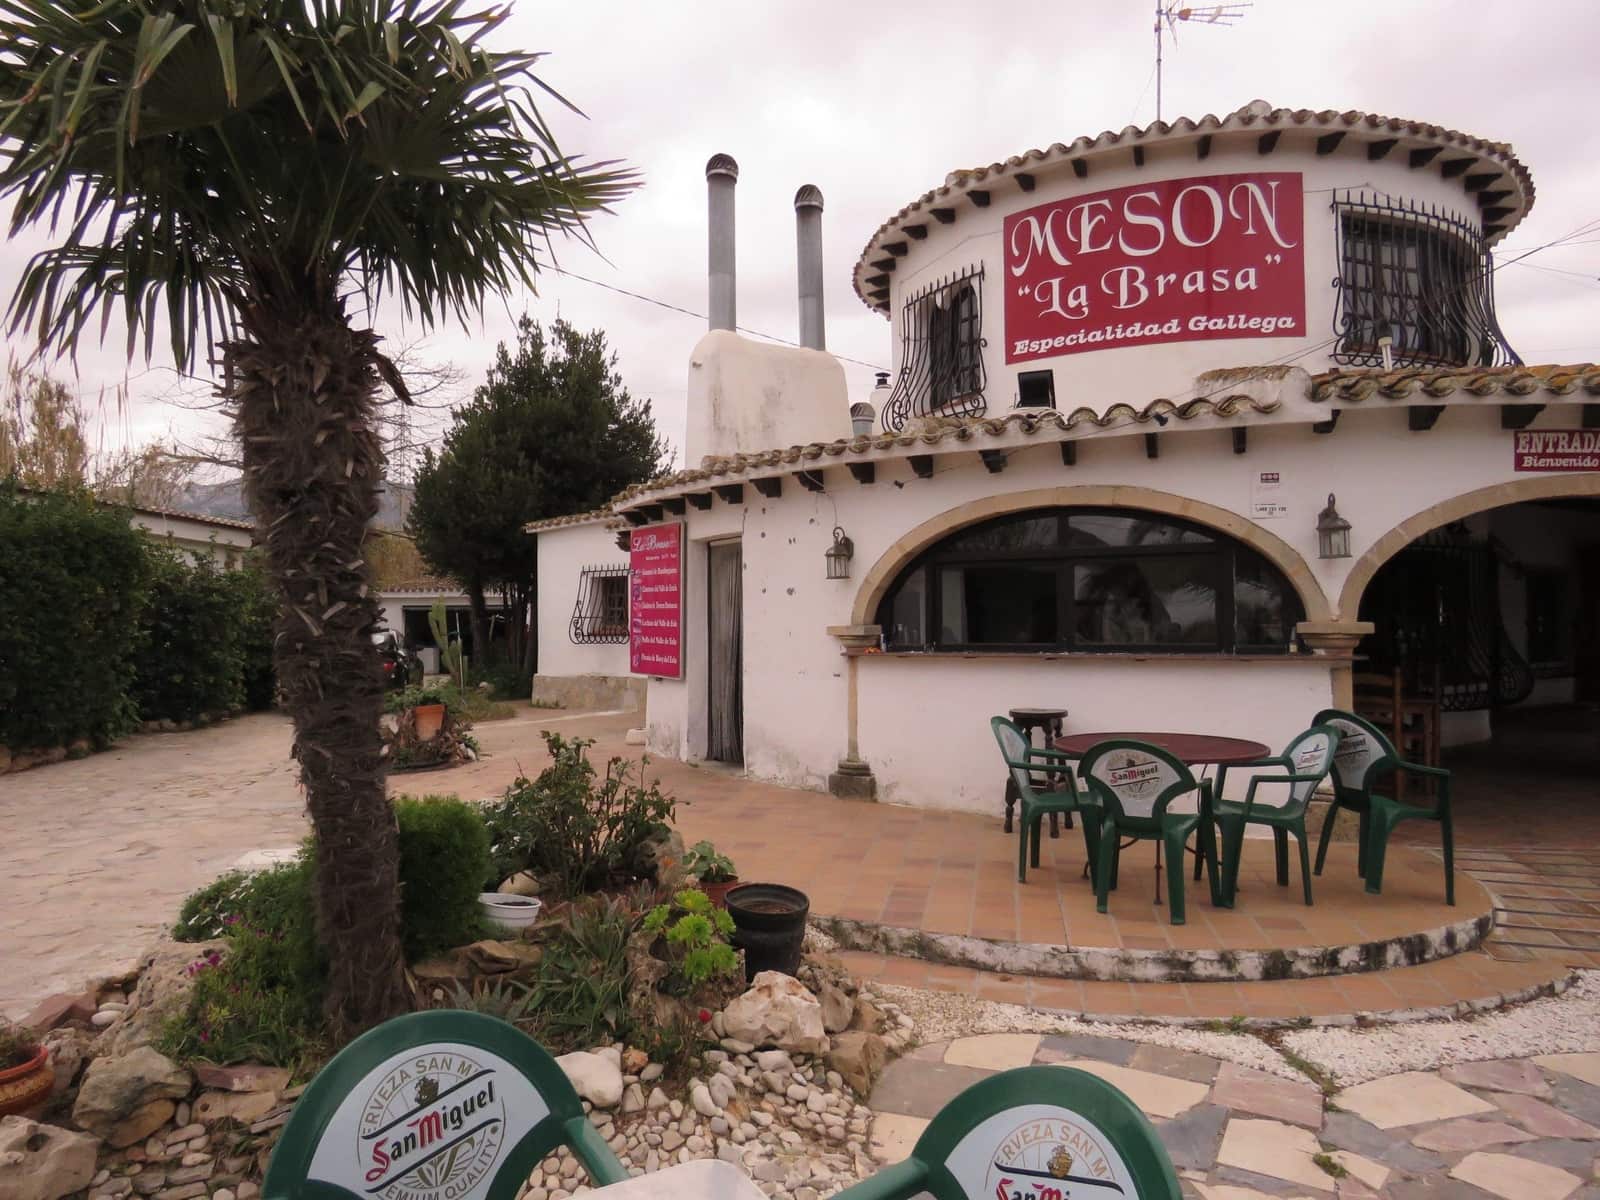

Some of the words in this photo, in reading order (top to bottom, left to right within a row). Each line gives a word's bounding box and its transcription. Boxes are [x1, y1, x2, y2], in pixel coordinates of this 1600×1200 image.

[1011, 181, 1297, 277] MESON
[1012, 319, 1181, 355] Especialidad
[1188, 314, 1295, 334] Gallega
[1521, 456, 1599, 467] Bienvenido
[416, 1057, 453, 1074] SAN
[457, 1061, 478, 1076] M
[1060, 1125, 1093, 1156] SAN
[445, 1139, 497, 1199] QUALITY
